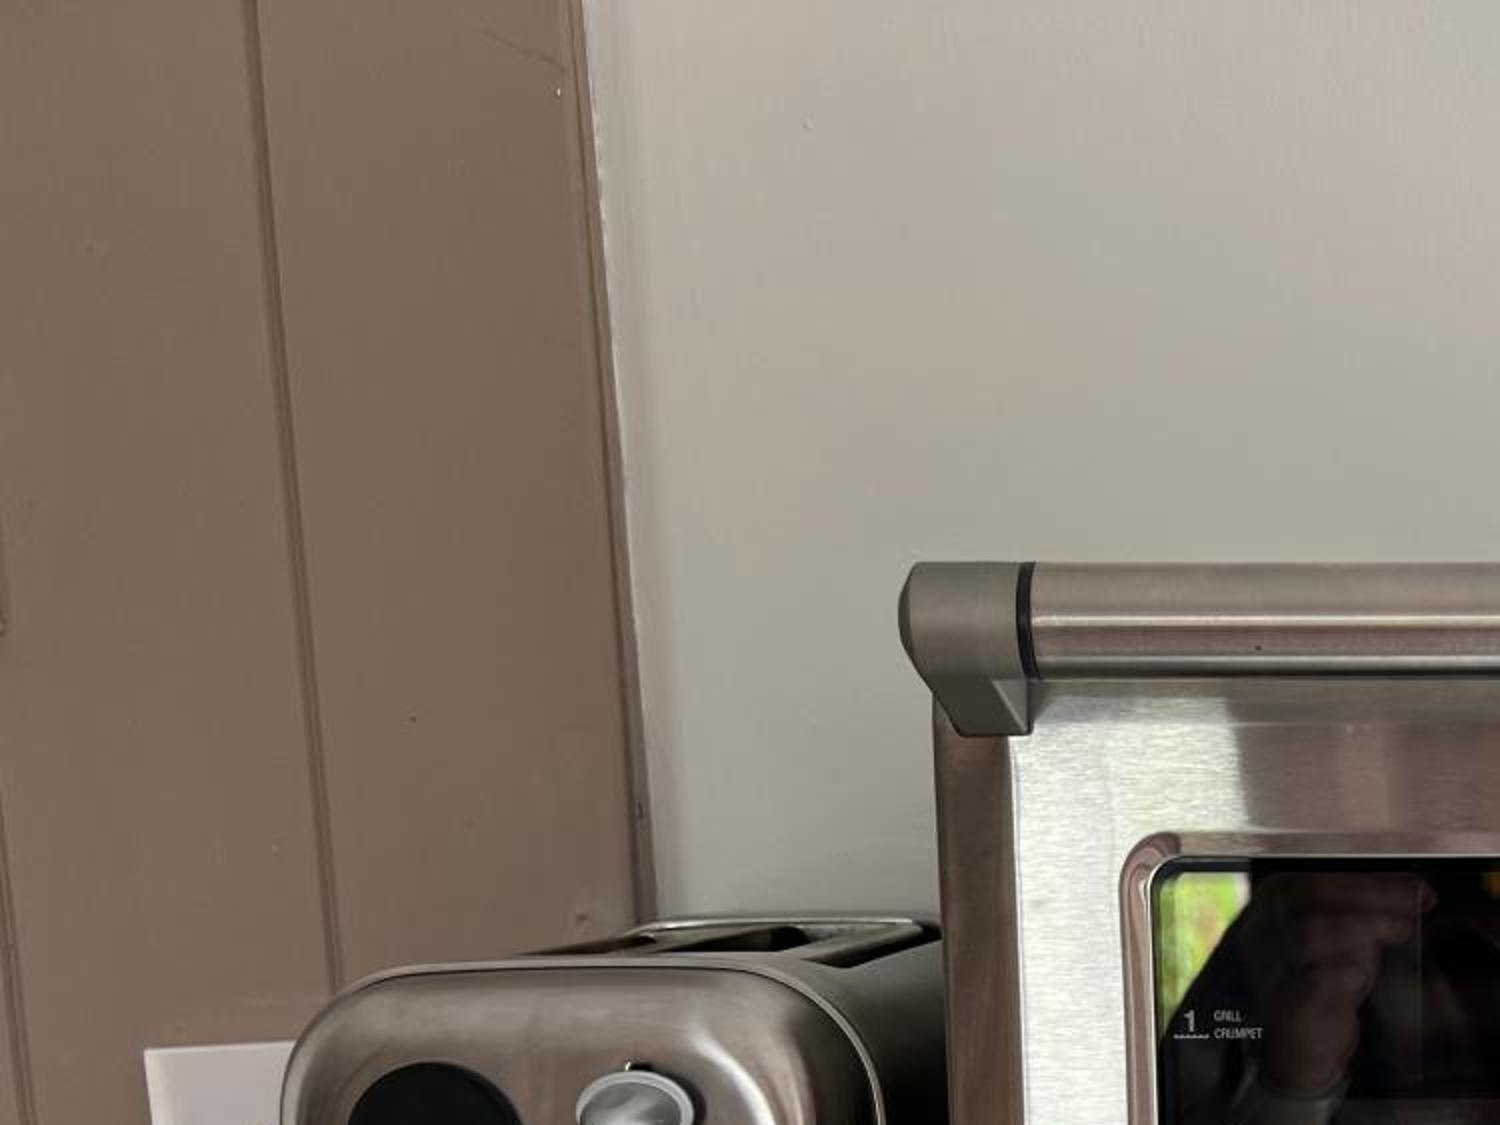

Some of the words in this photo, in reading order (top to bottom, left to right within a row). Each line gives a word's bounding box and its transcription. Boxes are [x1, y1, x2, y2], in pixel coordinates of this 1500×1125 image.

[1184, 1009, 1195, 1033] 1
[1213, 1009, 1243, 1022] GRILL
[1213, 1027, 1264, 1039] CRUMPET
